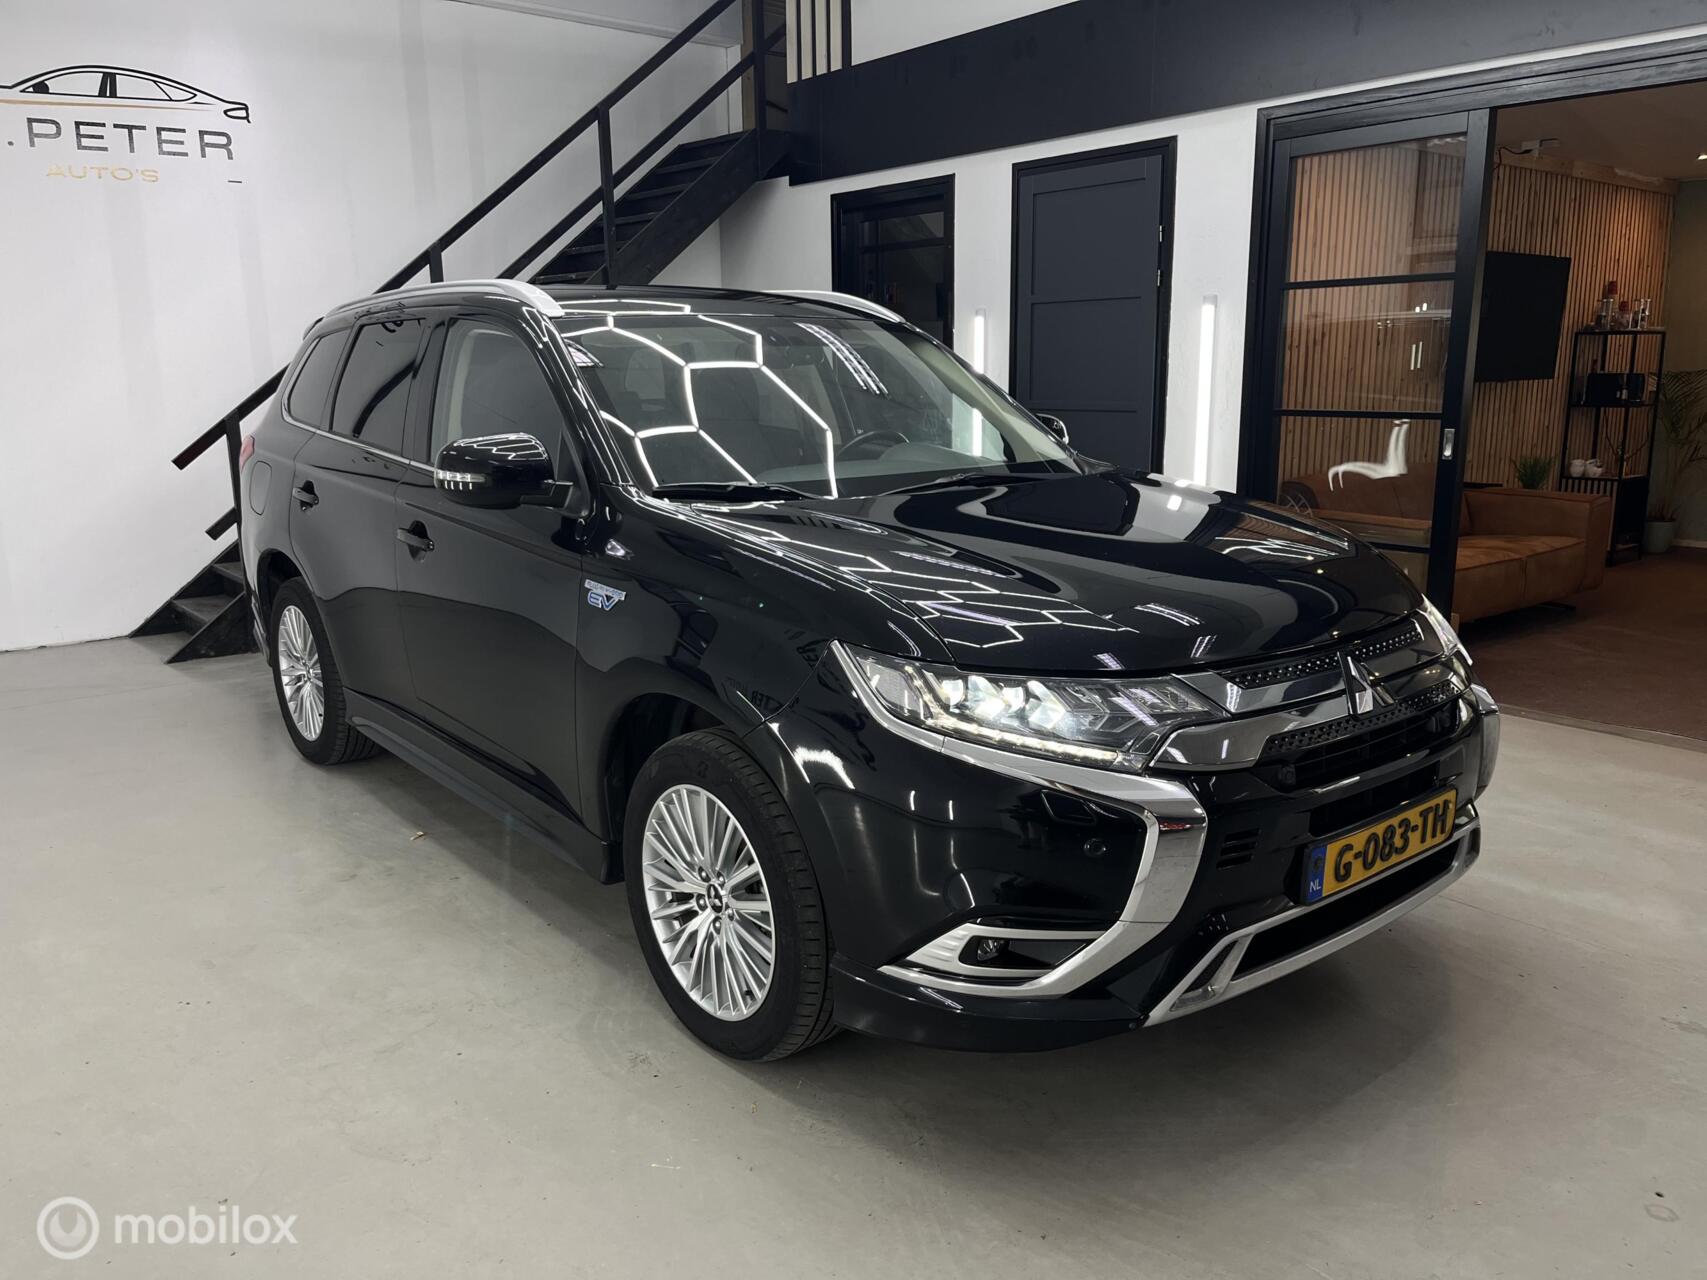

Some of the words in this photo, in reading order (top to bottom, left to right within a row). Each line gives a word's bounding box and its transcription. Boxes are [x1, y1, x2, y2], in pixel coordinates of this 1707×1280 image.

[46, 164, 160, 183] AUTO'S
[588, 590, 620, 611] EV
[1334, 799, 1450, 883] G-083-TH
[1309, 880, 1322, 893] NL
